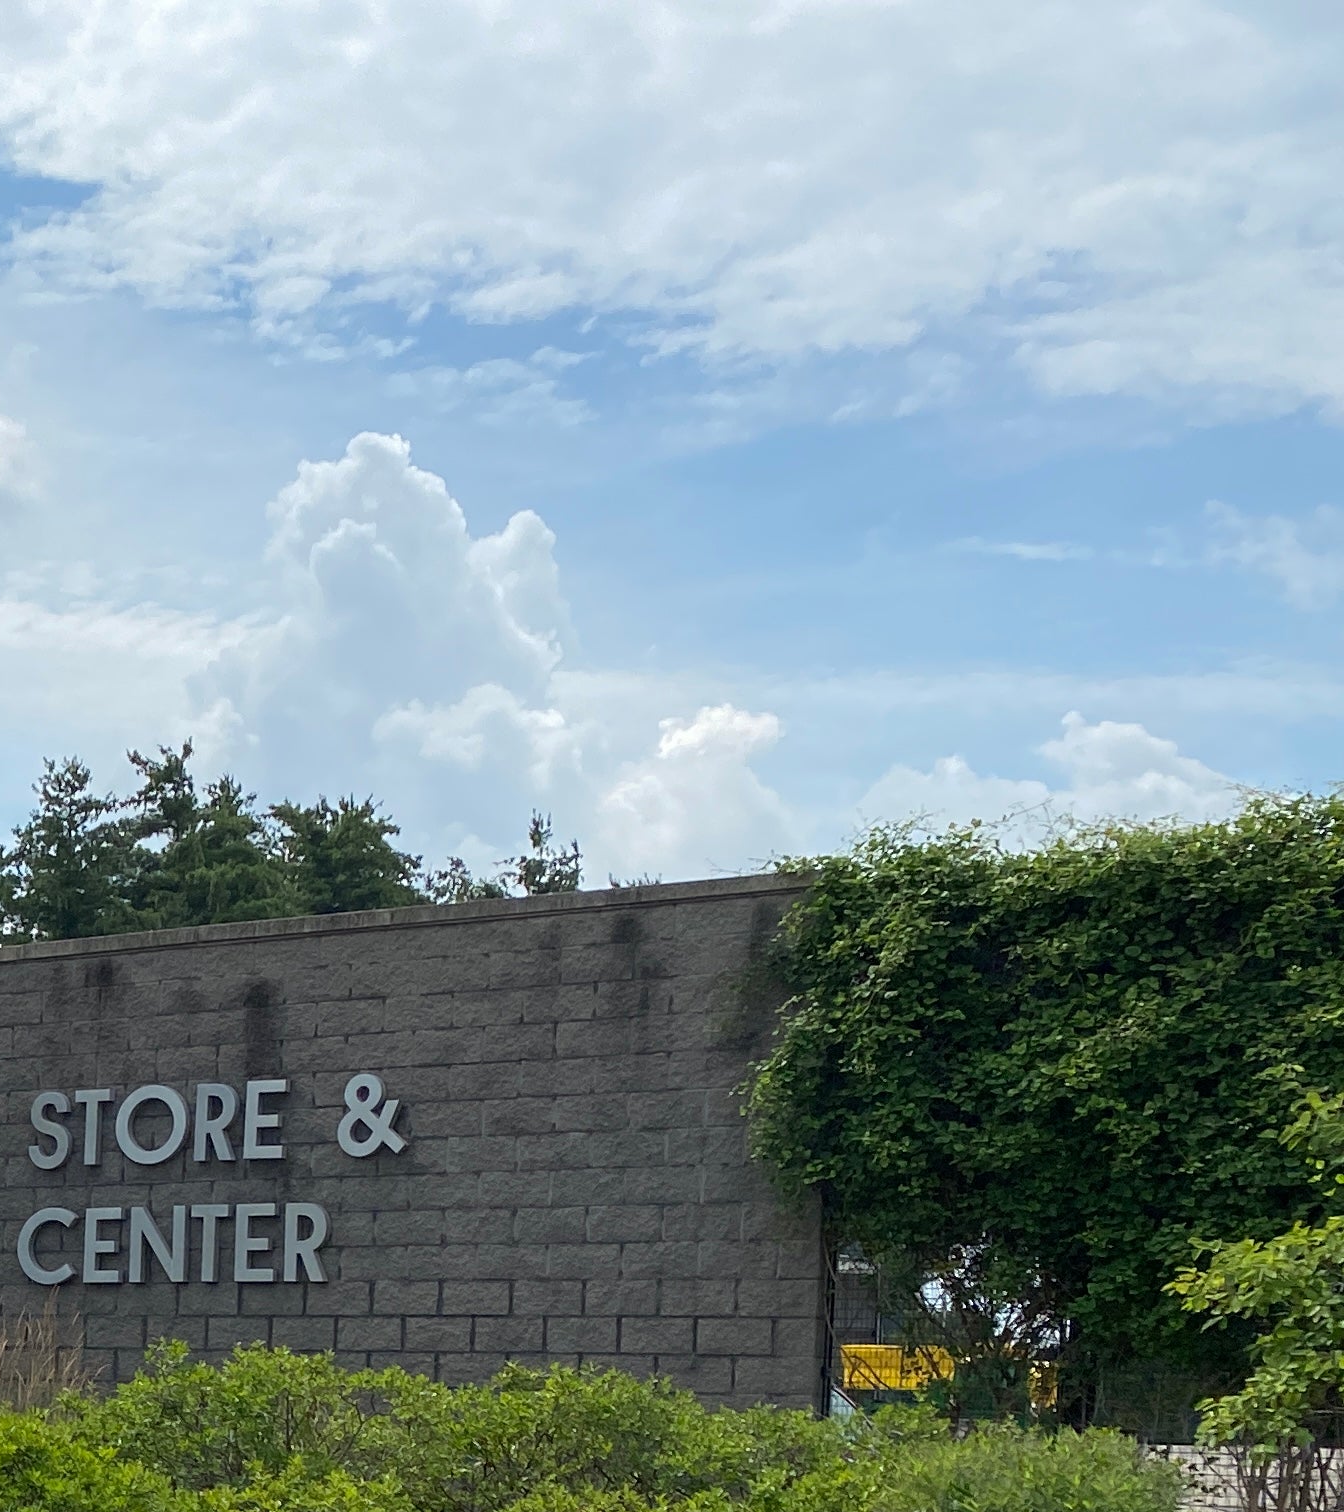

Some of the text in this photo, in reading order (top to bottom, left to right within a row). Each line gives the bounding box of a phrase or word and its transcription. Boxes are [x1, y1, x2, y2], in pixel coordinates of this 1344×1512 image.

[29, 1079, 289, 1170] STORE
[338, 1073, 407, 1158] &
[17, 1203, 330, 1285] CENTER
